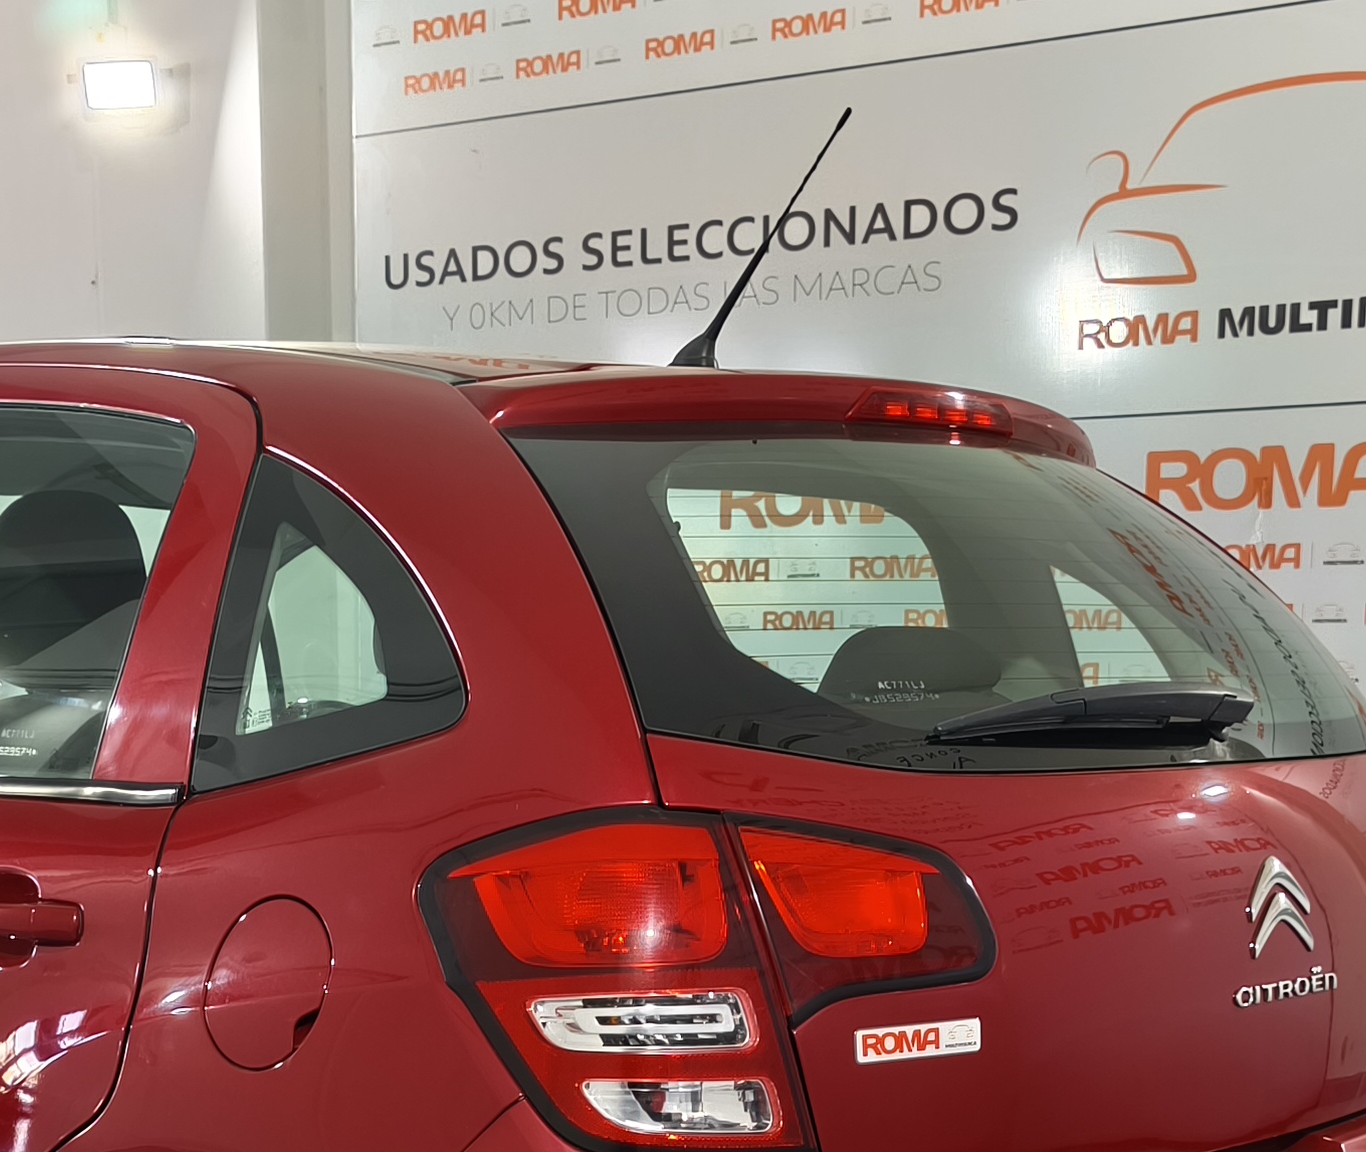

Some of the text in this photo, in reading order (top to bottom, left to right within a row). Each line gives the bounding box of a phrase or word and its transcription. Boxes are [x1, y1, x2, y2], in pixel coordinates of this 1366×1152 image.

[412, 10, 487, 44] ROMA
[770, 8, 847, 42] ROMA
[644, 29, 716, 61] ROMA
[404, 67, 467, 96] ROMA
[515, 50, 582, 80] ROMA
[384, 187, 1019, 291] USADOS SELECCIONADOS
[442, 304, 461, 331] Y
[546, 293, 588, 324] DE
[597, 282, 711, 319] TODAS
[793, 261, 943, 303] MARCAS
[1077, 310, 1199, 350] ROMA
[762, 610, 835, 631] ROMA
[861, 1026, 941, 1058] ROMA
